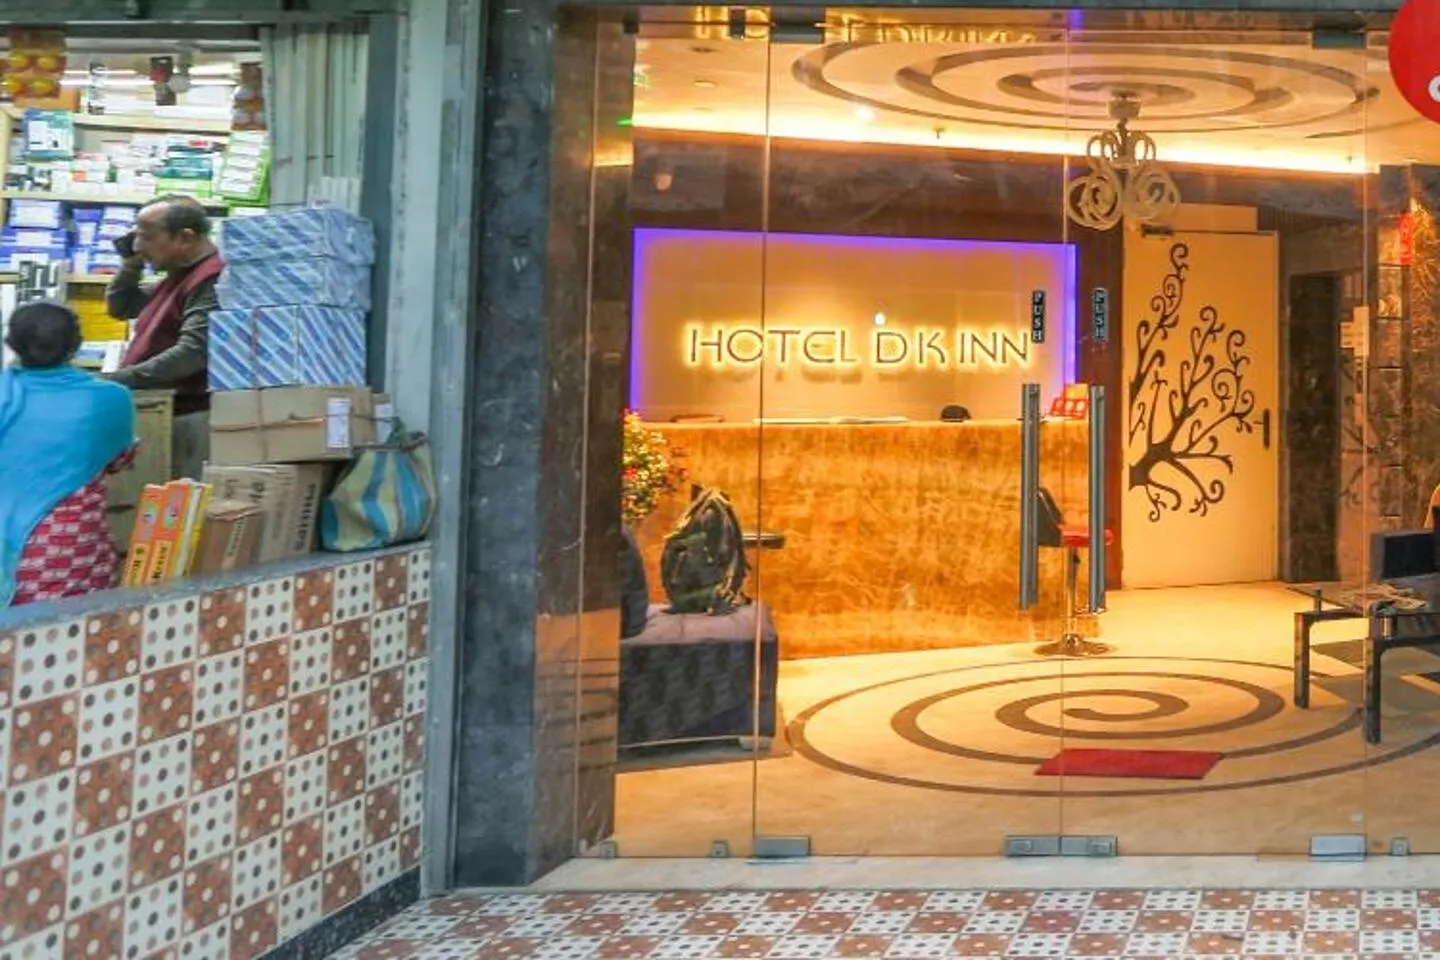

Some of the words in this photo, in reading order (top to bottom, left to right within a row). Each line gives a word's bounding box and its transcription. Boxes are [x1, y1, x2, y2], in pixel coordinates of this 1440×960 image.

[1032, 291, 1044, 341] PUSH
[690, 328, 857, 364] HOTEL
[959, 331, 1028, 364] INN
